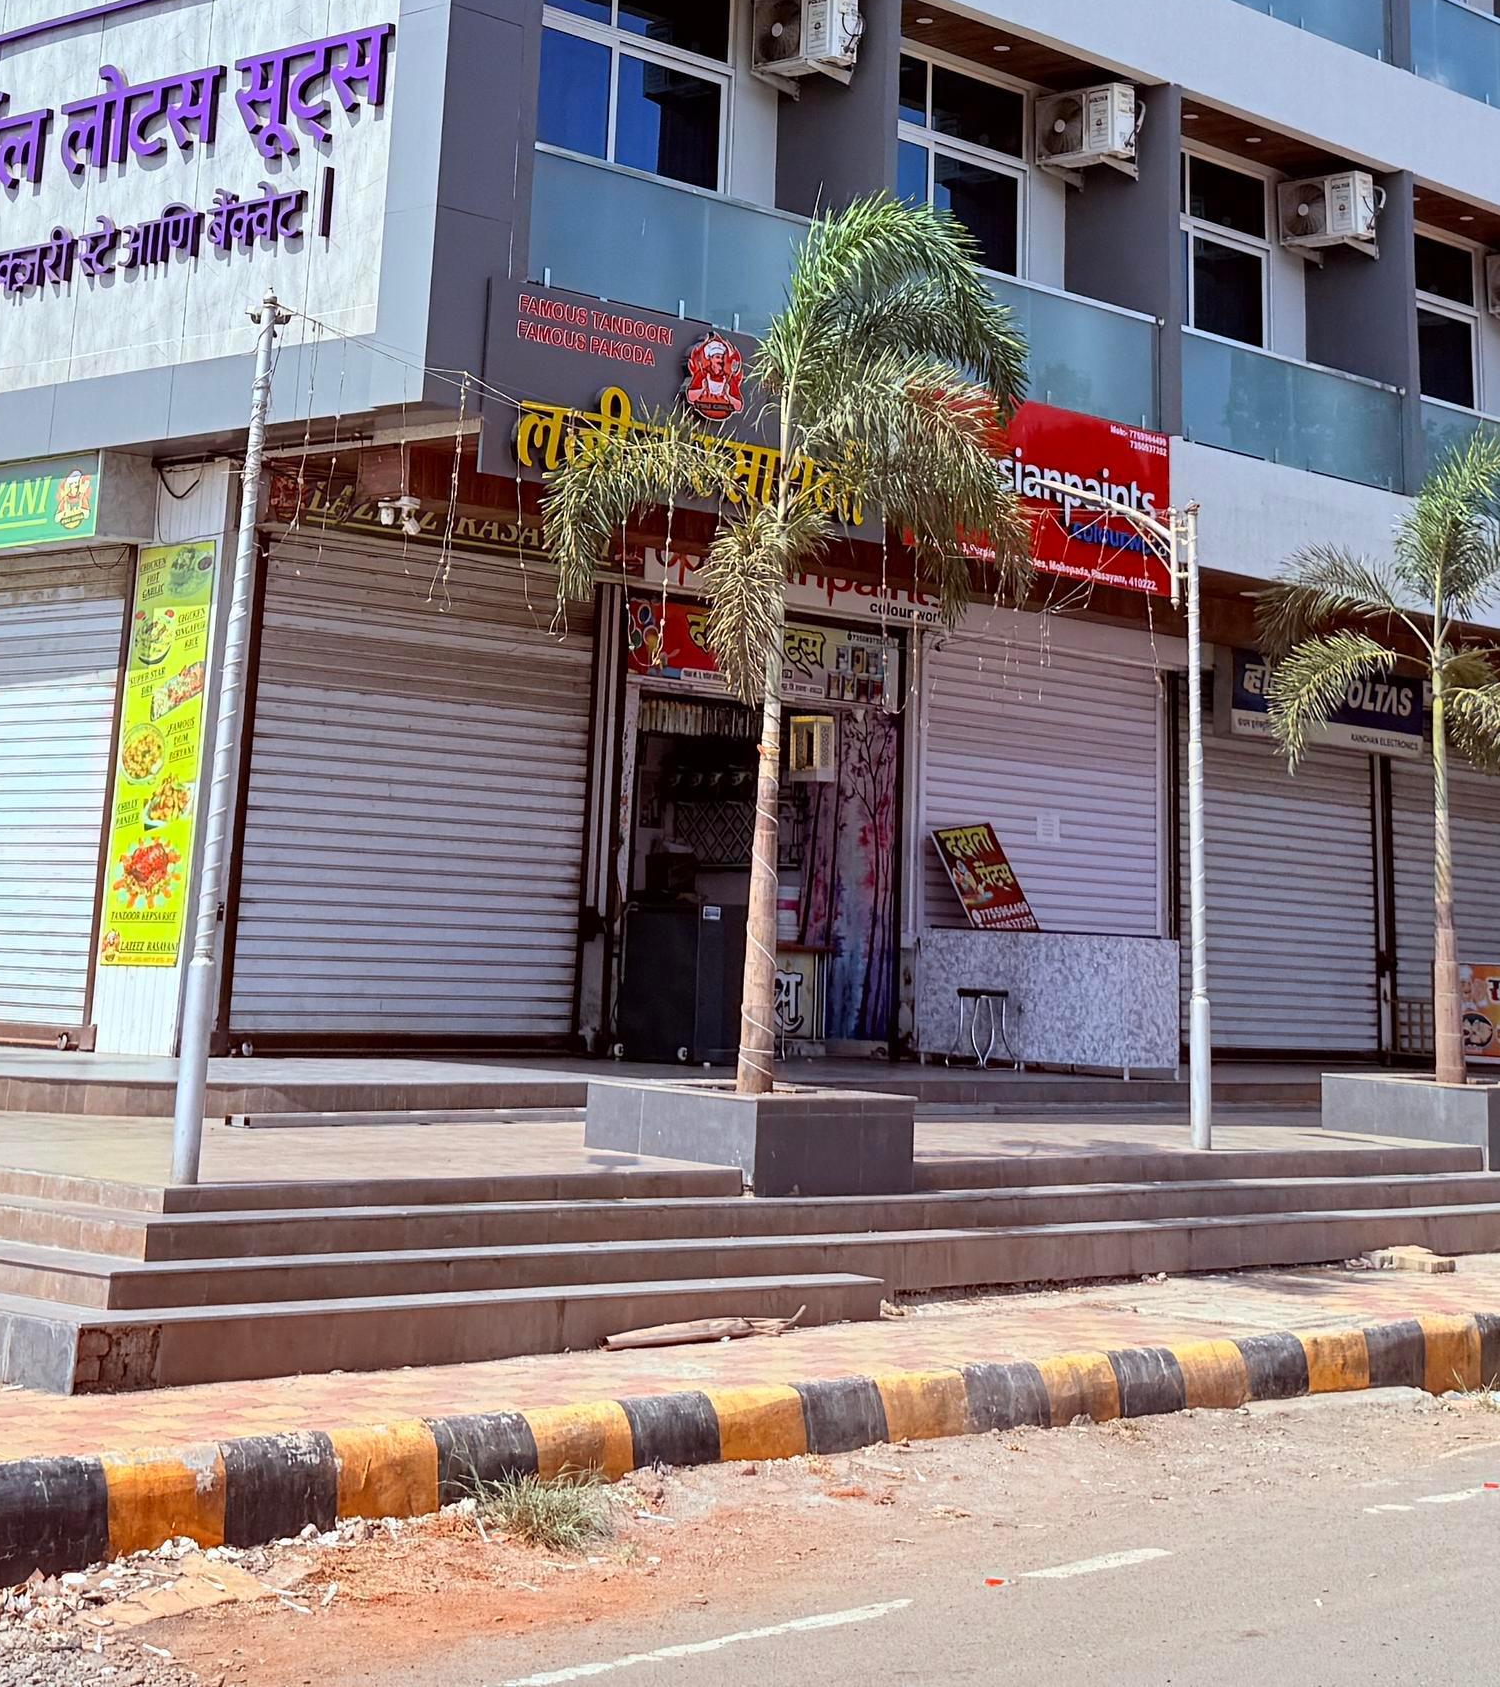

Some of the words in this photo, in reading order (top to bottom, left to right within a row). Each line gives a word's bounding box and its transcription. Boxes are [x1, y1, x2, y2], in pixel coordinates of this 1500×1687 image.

[61, 64, 228, 175] लोटस
[234, 22, 397, 159] सूट्स
[118, 201, 206, 270] आणि
[516, 319, 587, 352] FAMOUS
[589, 338, 656, 367] PAKODA
[518, 293, 588, 325] FAMOUS
[591, 310, 674, 347] TANDOORI
[1338, 678, 1414, 718] OLTAS
